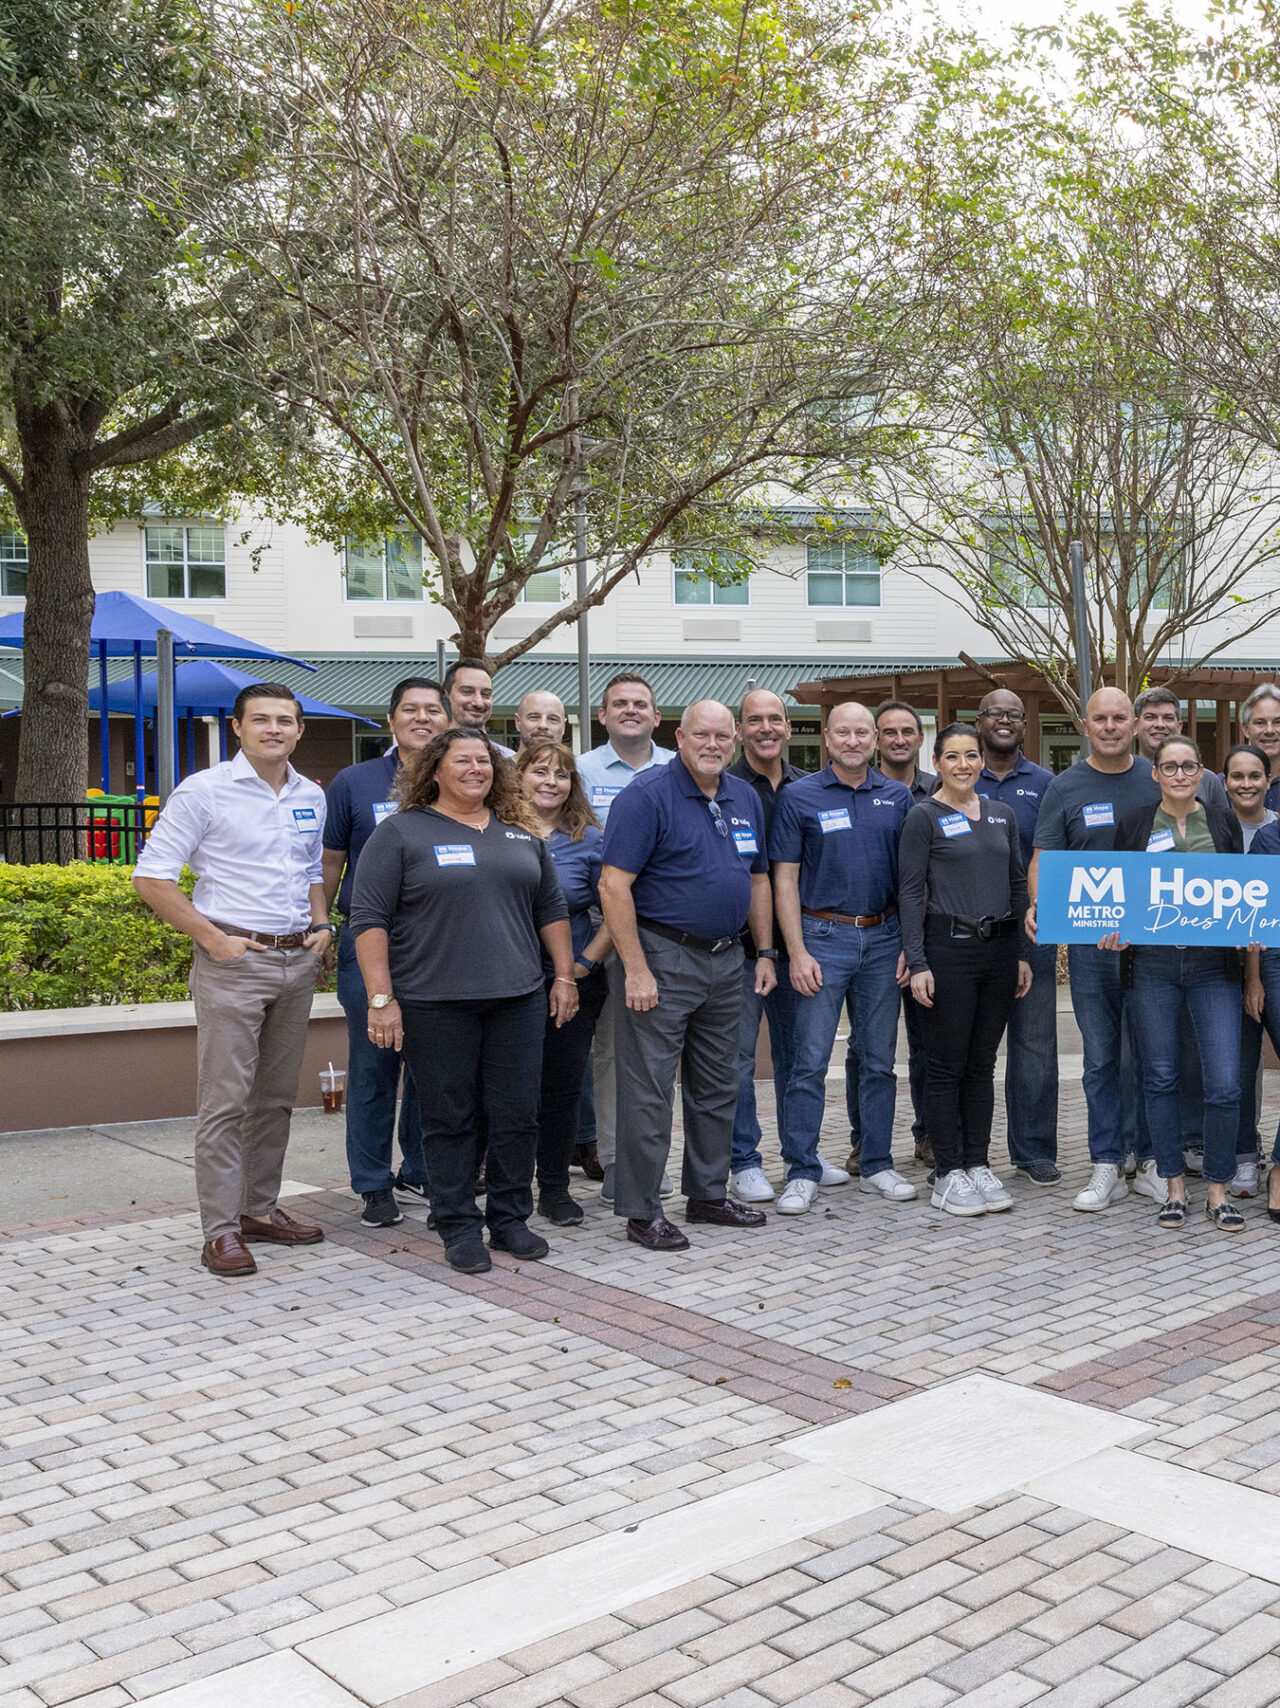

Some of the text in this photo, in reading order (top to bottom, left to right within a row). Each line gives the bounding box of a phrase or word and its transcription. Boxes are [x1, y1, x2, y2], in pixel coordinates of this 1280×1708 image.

[1149, 867, 1270, 919] Hope
[1068, 905, 1125, 919] METRO
[1072, 919, 1120, 928] MINISTRIES
[1144, 898, 1219, 934] Does
